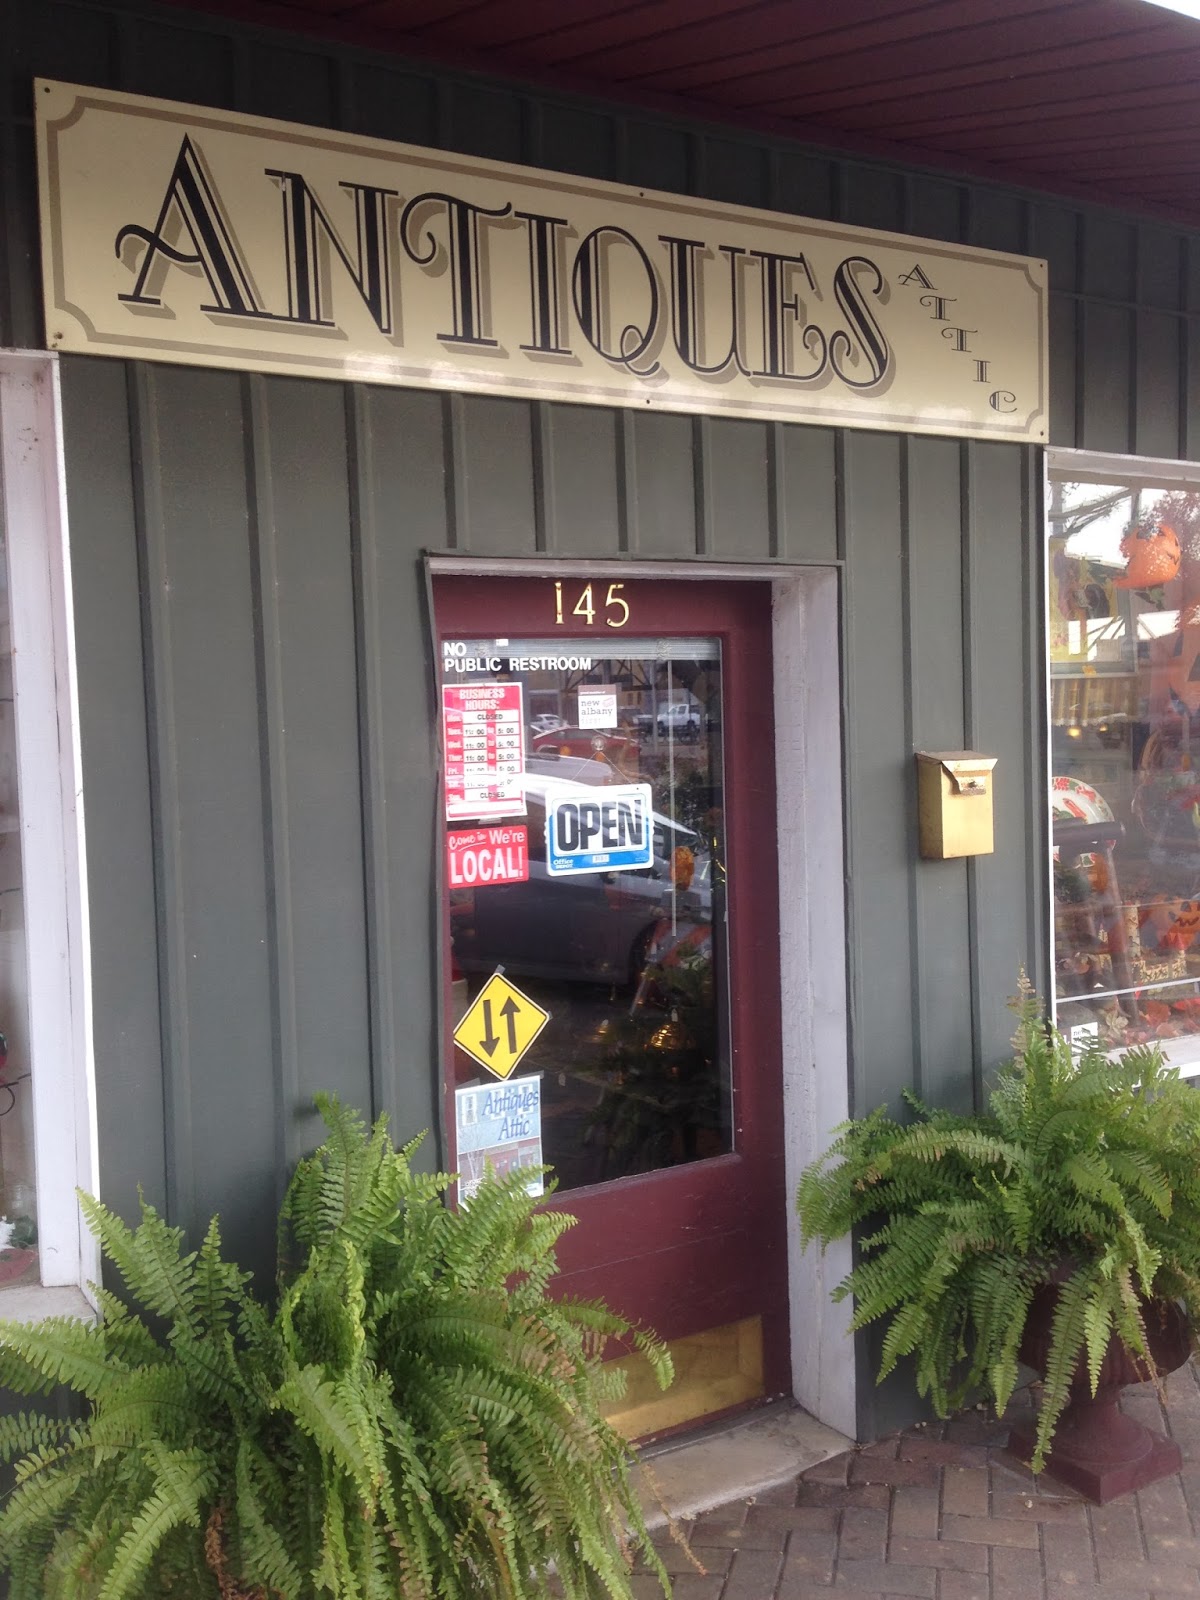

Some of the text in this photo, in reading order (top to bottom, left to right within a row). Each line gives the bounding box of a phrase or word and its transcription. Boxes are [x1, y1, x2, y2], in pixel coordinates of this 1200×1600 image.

[115, 132, 890, 389] ANTIQUES
[898, 264, 1018, 413] ATTIC
[555, 581, 630, 628] 145
[443, 642, 467, 657] NO
[444, 656, 592, 672] PUBLIC RESTROOM
[459, 688, 505, 700] BUSINESS
[465, 700, 500, 711] HOURS:
[581, 707, 613, 717] albany
[479, 791, 506, 799] CLOSED
[556, 799, 643, 852] OPEN
[449, 835, 476, 851] Come
[489, 829, 525, 845] We're
[450, 846, 524, 885] LOCAL!
[553, 857, 574, 866] Office
[481, 1088, 539, 1116] Antiques
[498, 1115, 531, 1141] Attic
